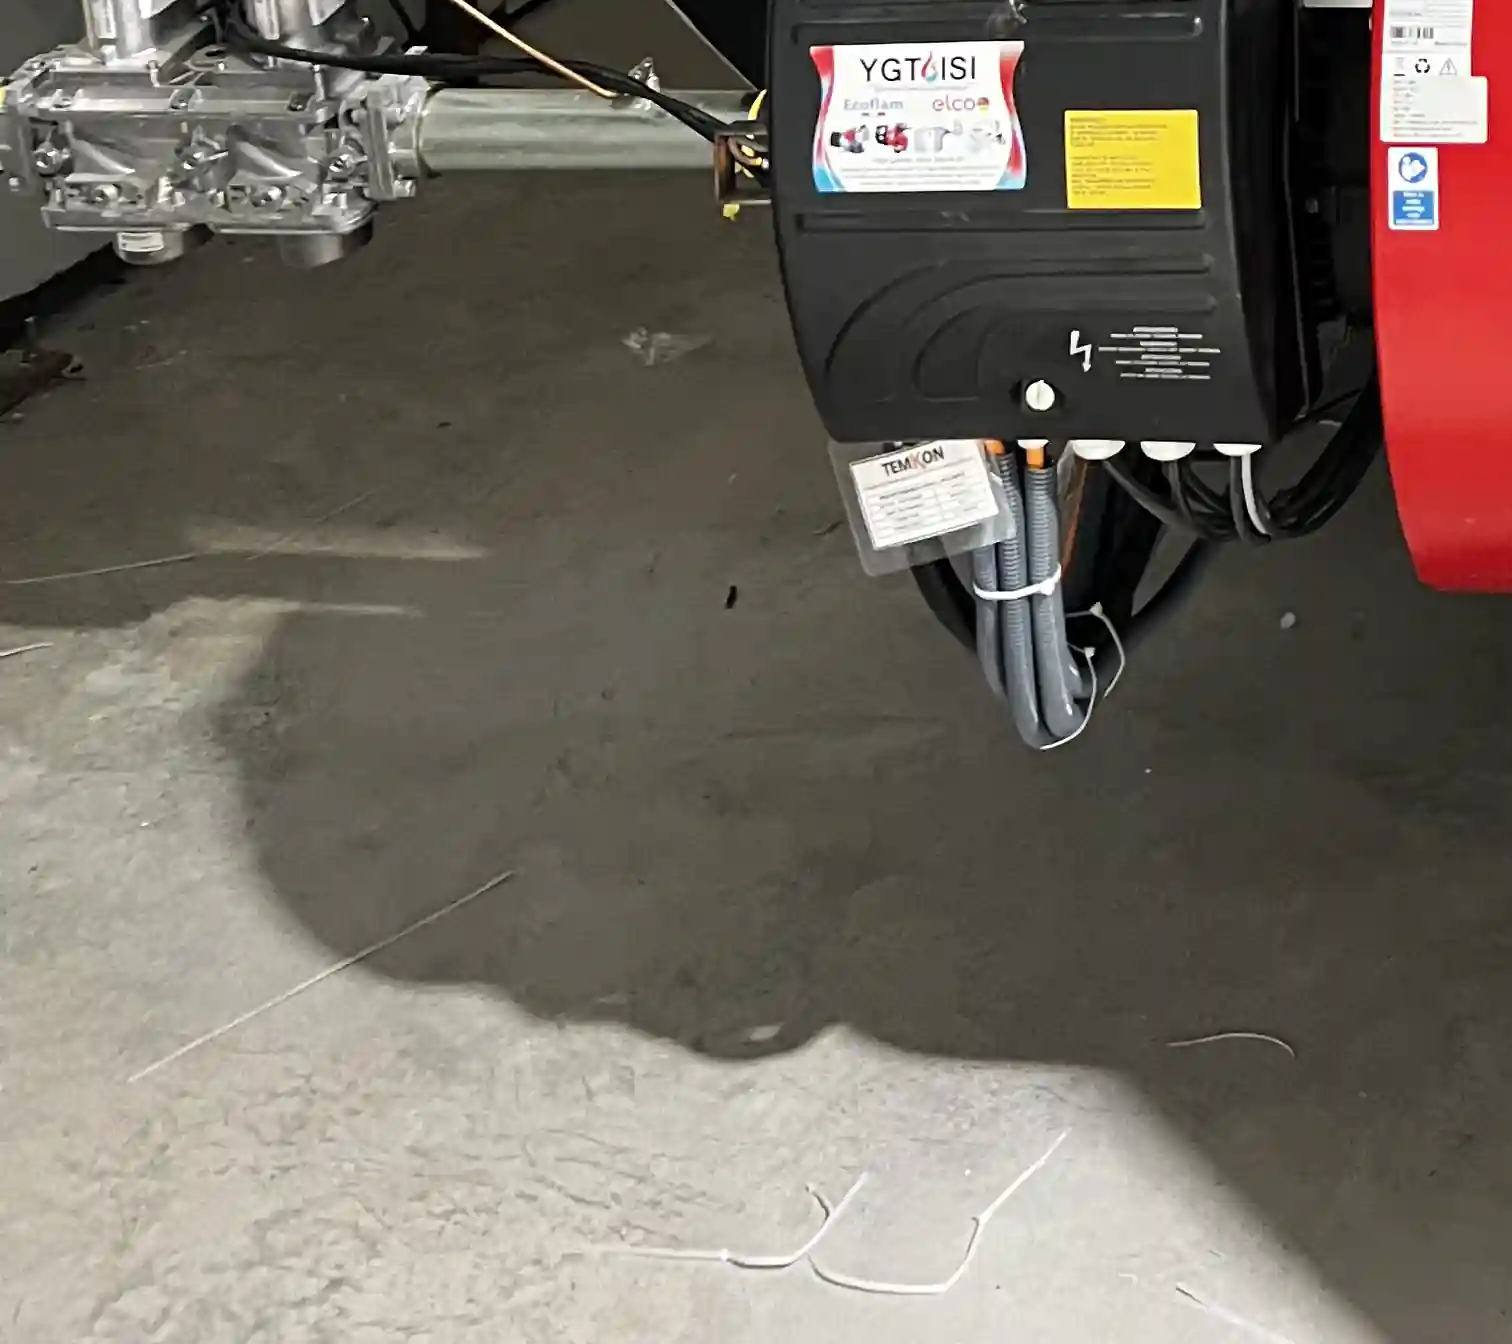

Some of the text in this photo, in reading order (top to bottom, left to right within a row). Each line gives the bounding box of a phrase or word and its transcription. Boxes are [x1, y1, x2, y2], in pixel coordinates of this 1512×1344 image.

[860, 57, 921, 82] YGT
[844, 98, 904, 111] Ecoflam
[882, 446, 945, 477] TEMKON
